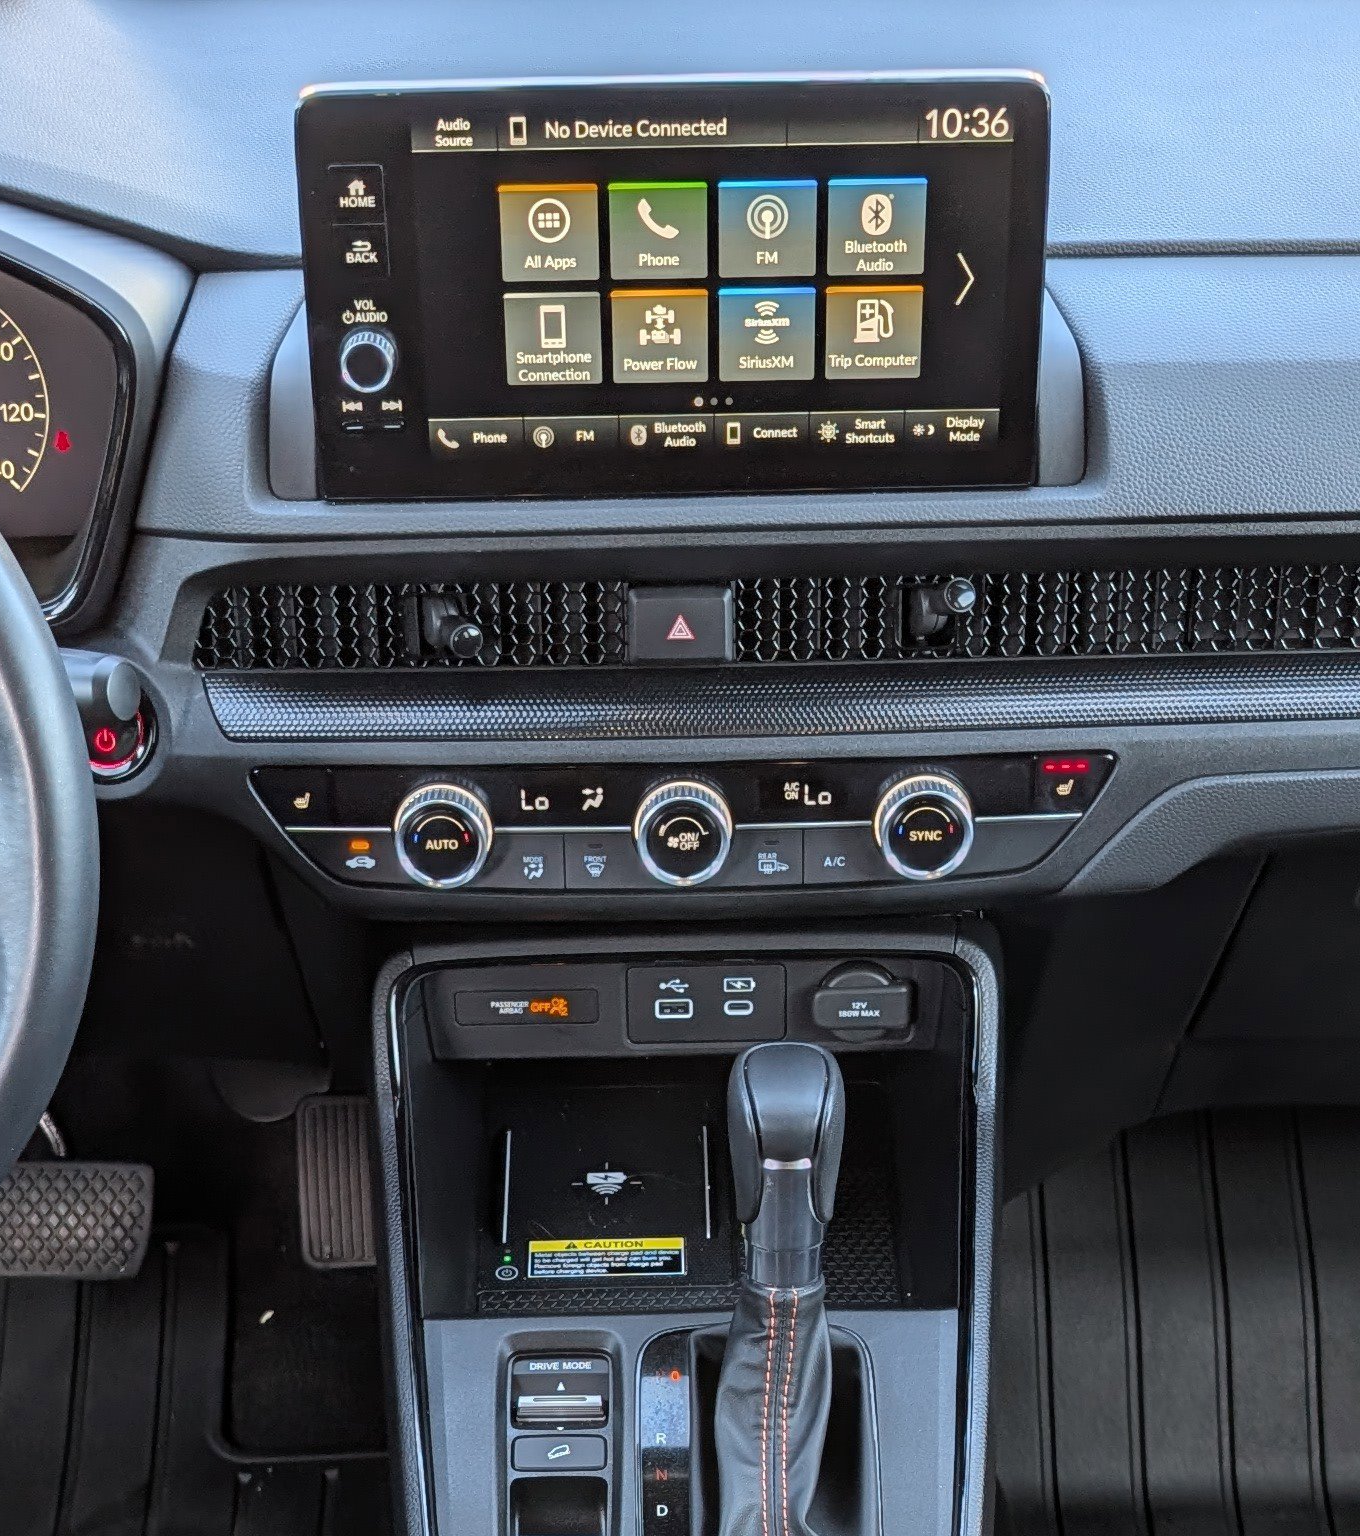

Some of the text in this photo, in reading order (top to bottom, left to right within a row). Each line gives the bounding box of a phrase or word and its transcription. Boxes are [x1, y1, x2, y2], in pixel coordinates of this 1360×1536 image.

[436, 117, 471, 131] Audio
[544, 117, 727, 139] No Device Connected
[925, 107, 1010, 139] 10:36
[434, 134, 474, 147] Source
[339, 196, 376, 208] HOME
[844, 239, 907, 253] Bluetooth
[345, 252, 379, 264] BACK
[524, 255, 577, 270] All Apps
[638, 253, 680, 267] Phone
[756, 251, 778, 265] FM
[855, 259, 894, 272] Audio
[353, 299, 376, 311] VOL
[354, 311, 388, 323] AUDIO
[516, 351, 592, 366] Smartphone
[623, 357, 698, 371] Power Flow
[739, 355, 794, 369] SiriusXM
[828, 354, 918, 370] Trip Computer
[518, 369, 591, 382] Connection
[0, 402, 34, 422] 120
[654, 421, 707, 434] Bluetooth
[854, 418, 886, 430] Smart
[946, 416, 985, 430] Display
[472, 431, 508, 444] Phone
[575, 430, 595, 442] FM
[753, 427, 798, 439] Connect
[845, 432, 896, 445] Shortcuts
[949, 430, 980, 442] Mode
[664, 435, 697, 448] Audio
[784, 782, 800, 792] A/C
[520, 788, 550, 811] Lo
[784, 791, 799, 801] ON
[804, 784, 832, 806] Lo
[679, 832, 700, 843] ON/
[909, 830, 942, 842] SYNC
[425, 839, 459, 851] AUTO
[679, 841, 700, 851] OFF
[522, 856, 544, 864] MODE
[583, 855, 607, 863] FRONT
[823, 856, 846, 868] A/C
[498, 1007, 524, 1015] AIRBAG
[530, 1001, 551, 1013] OFF
[851, 1001, 868, 1010] 12V
[860, 1009, 881, 1017] MAX
[583, 1240, 644, 1249] CAUTION
[529, 1361, 592, 1371] DRIVE MODE
[656, 1432, 667, 1445] R
[656, 1469, 668, 1481] N
[656, 1504, 669, 1517] D
